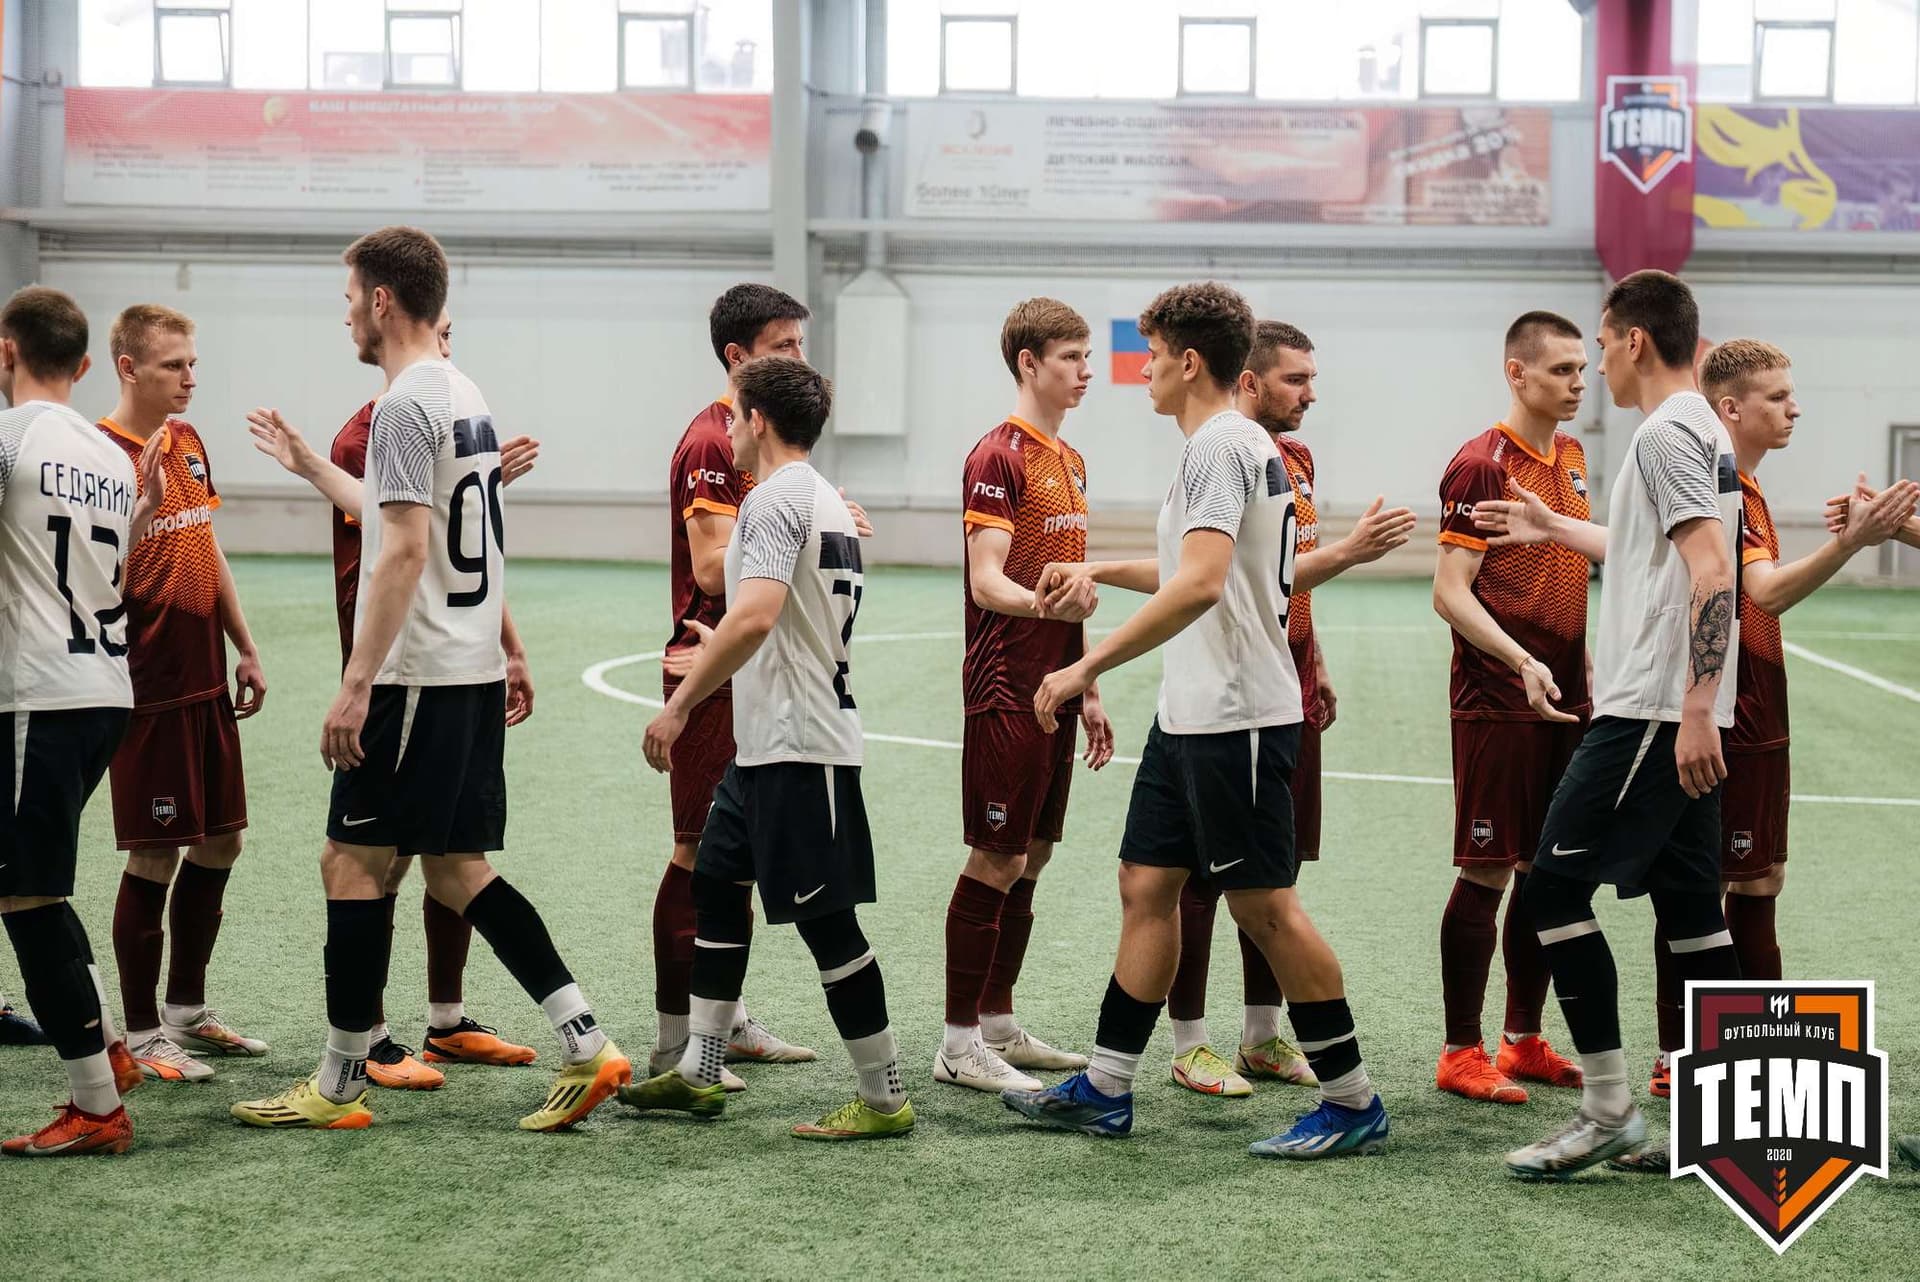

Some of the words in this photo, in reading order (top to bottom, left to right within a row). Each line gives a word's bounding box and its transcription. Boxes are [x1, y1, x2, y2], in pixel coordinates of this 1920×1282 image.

[1610, 108, 1683, 149] ТЕМП
[974, 481, 1006, 499] ПСБ
[47, 514, 130, 657] 12
